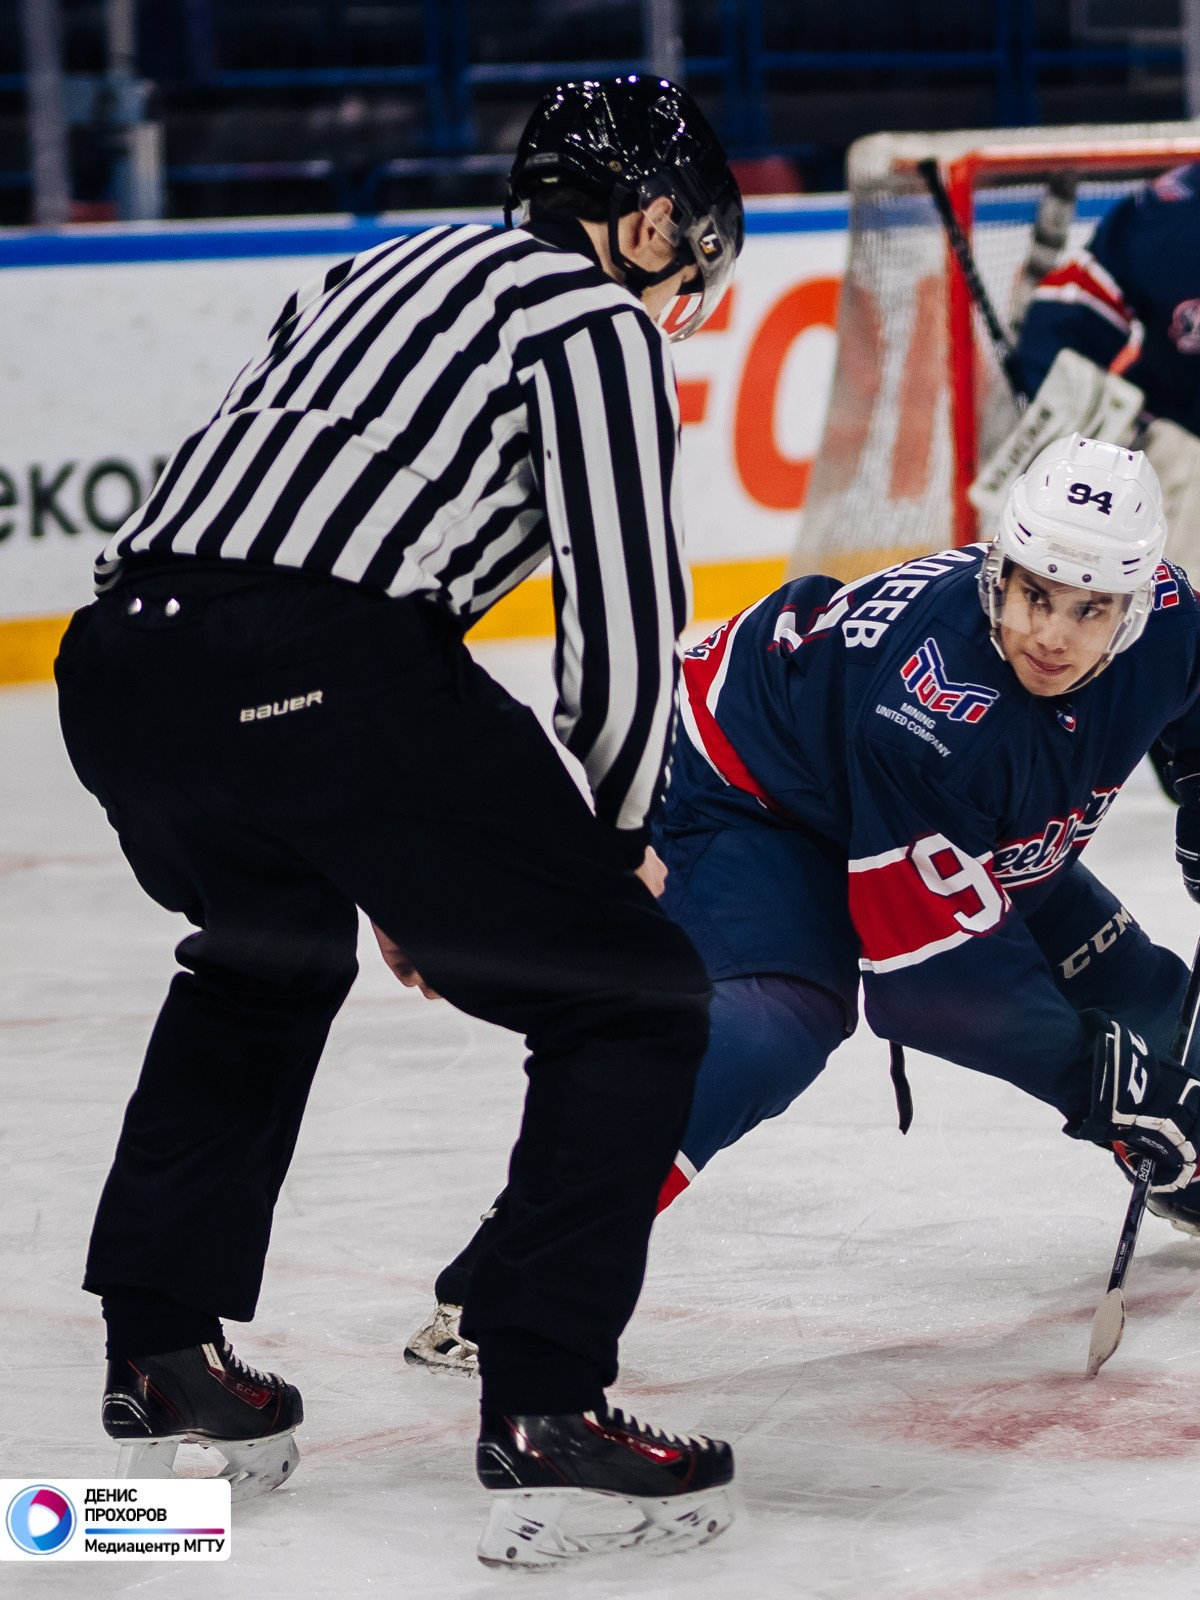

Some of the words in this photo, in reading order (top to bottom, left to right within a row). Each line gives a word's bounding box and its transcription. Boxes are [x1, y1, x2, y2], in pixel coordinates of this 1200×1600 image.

[1067, 482, 1113, 516] 94
[841, 542, 985, 648] АДЕЕВ
[240, 690, 323, 722] BAUER
[875, 704, 908, 726] UNITED
[906, 720, 952, 757] COMPANY
[900, 702, 937, 730] MINING
[911, 833, 1011, 933] 9
[1058, 906, 1135, 979] CCM
